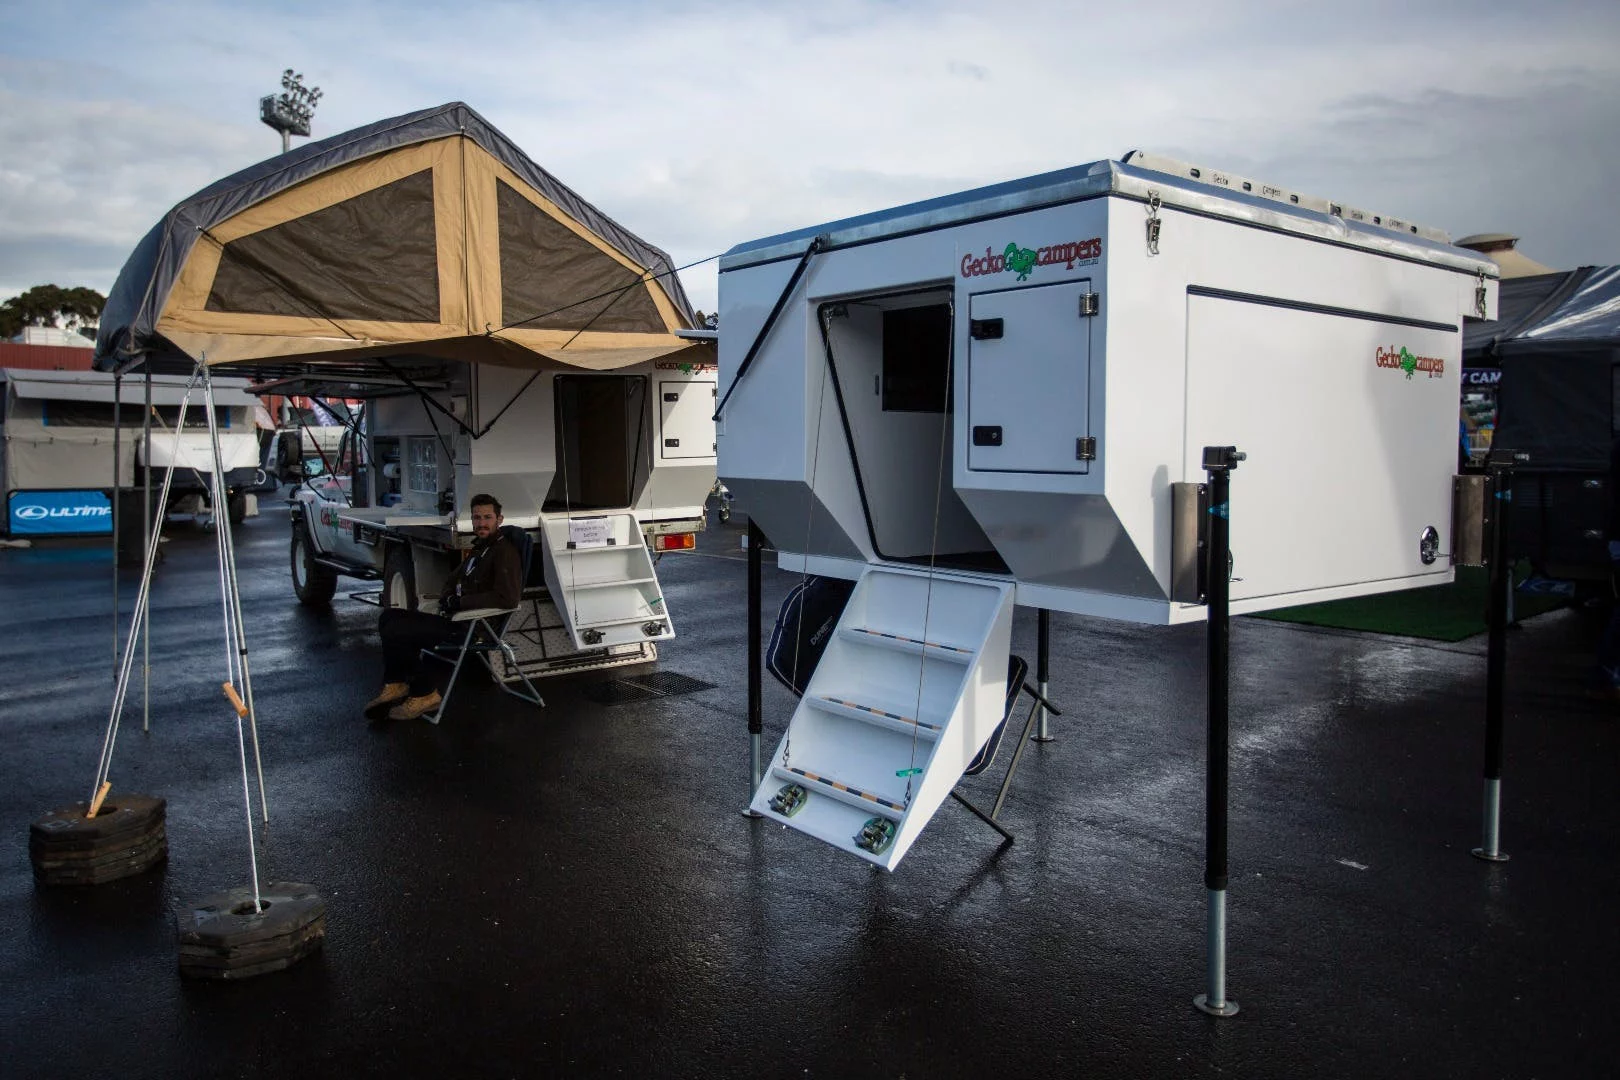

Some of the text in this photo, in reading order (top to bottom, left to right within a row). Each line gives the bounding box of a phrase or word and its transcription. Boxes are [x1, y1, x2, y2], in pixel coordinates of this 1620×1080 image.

[960, 237, 1102, 278] Gecko campers
[1375, 344, 1444, 378] Gecko campers
